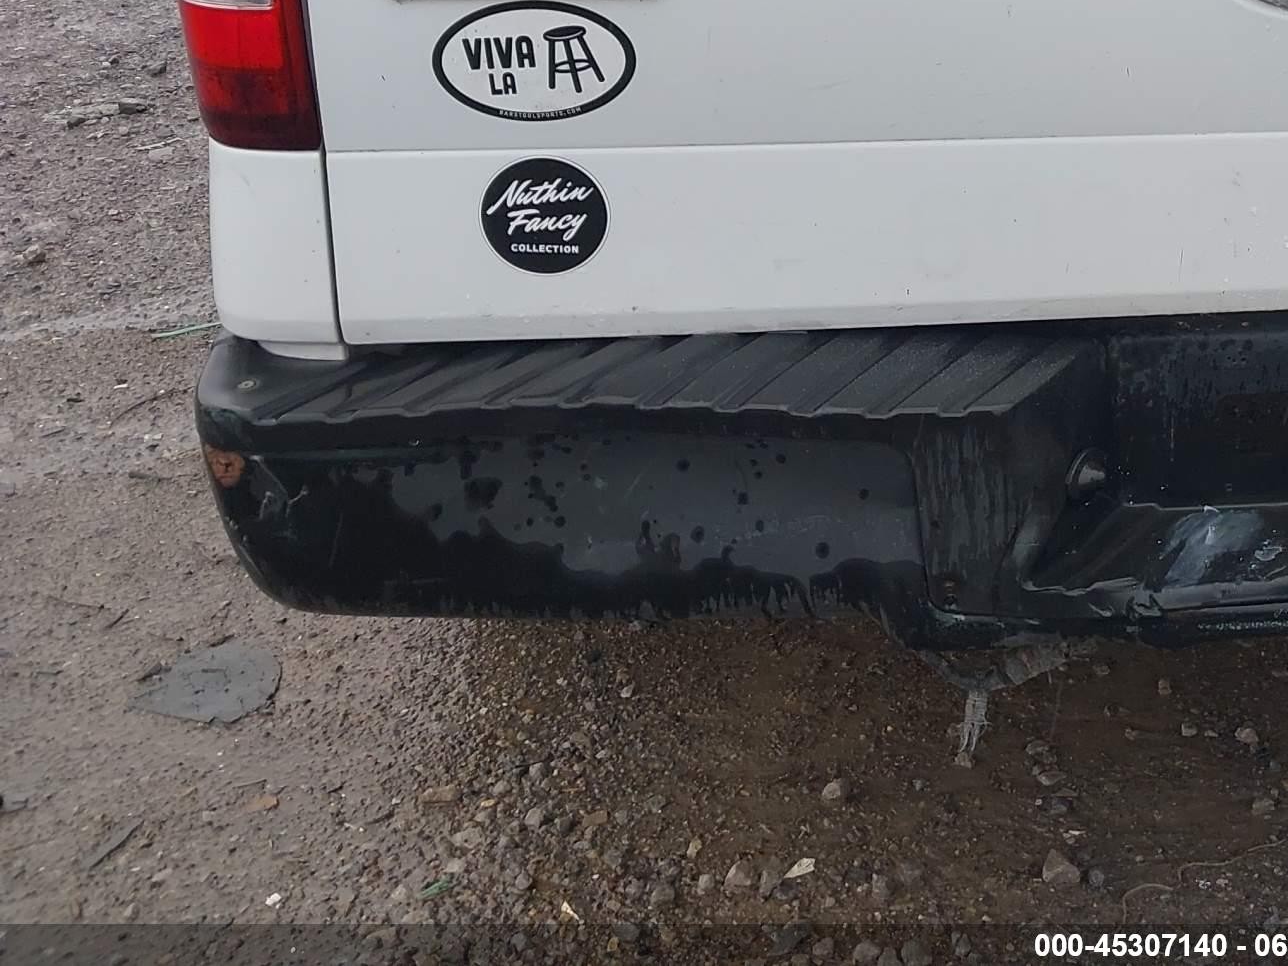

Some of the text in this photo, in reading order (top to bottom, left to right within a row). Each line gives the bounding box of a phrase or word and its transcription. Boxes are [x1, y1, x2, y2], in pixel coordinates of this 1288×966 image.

[462, 35, 536, 71] VIVA
[488, 72, 518, 95] LA
[486, 178, 594, 215] Nuthin
[507, 208, 589, 241] Fancy
[511, 243, 579, 254] COLLECTION
